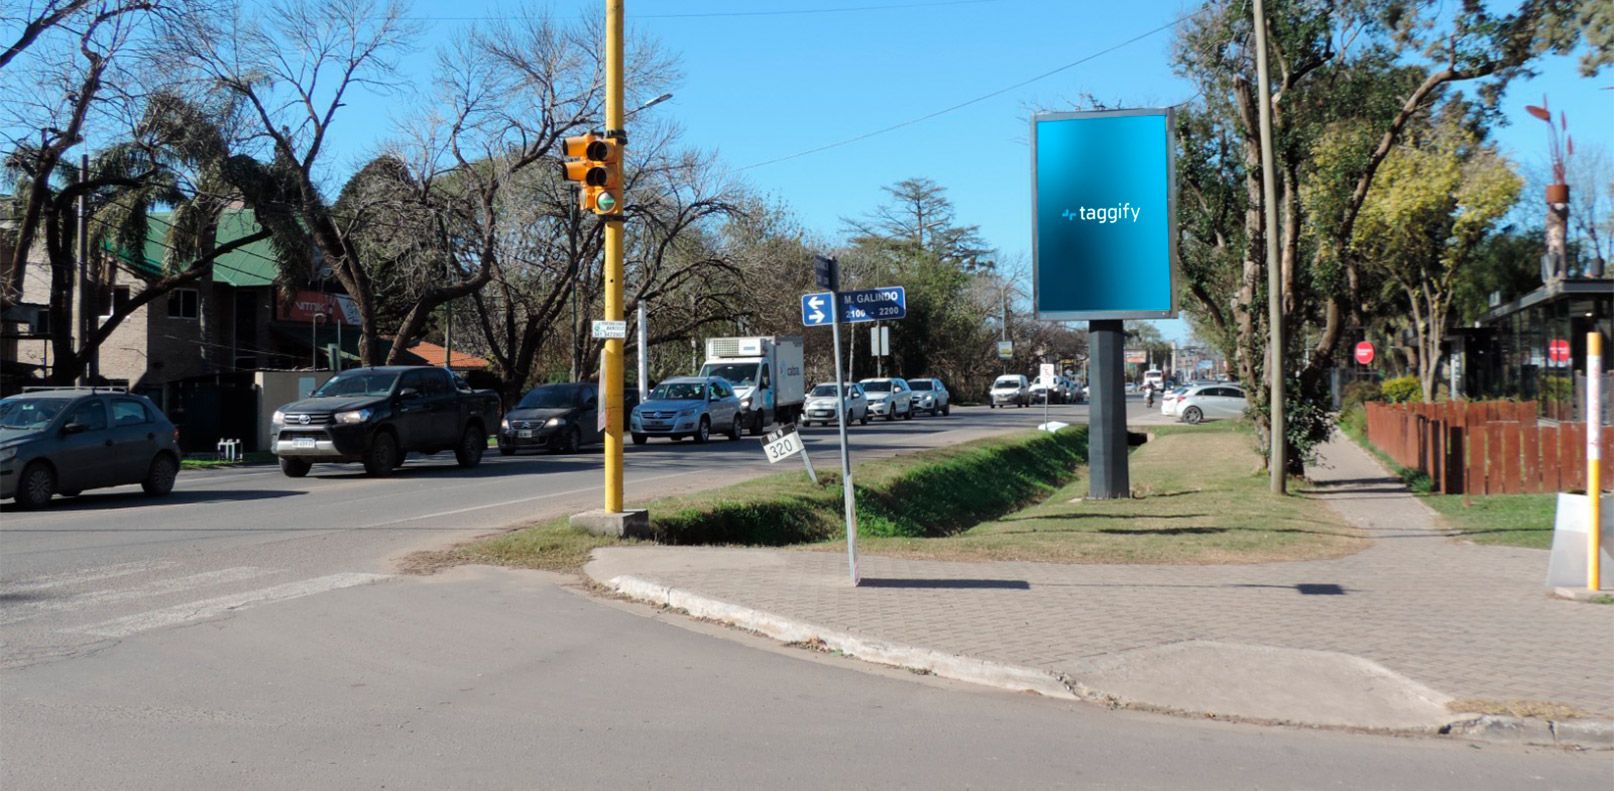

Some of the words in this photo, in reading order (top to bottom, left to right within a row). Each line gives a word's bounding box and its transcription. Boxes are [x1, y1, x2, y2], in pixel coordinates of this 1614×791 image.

[1079, 202, 1141, 224] taggify
[843, 295, 855, 304] M.
[856, 291, 899, 303] GALINDO
[879, 306, 900, 316] 2200
[769, 439, 793, 459] 320
